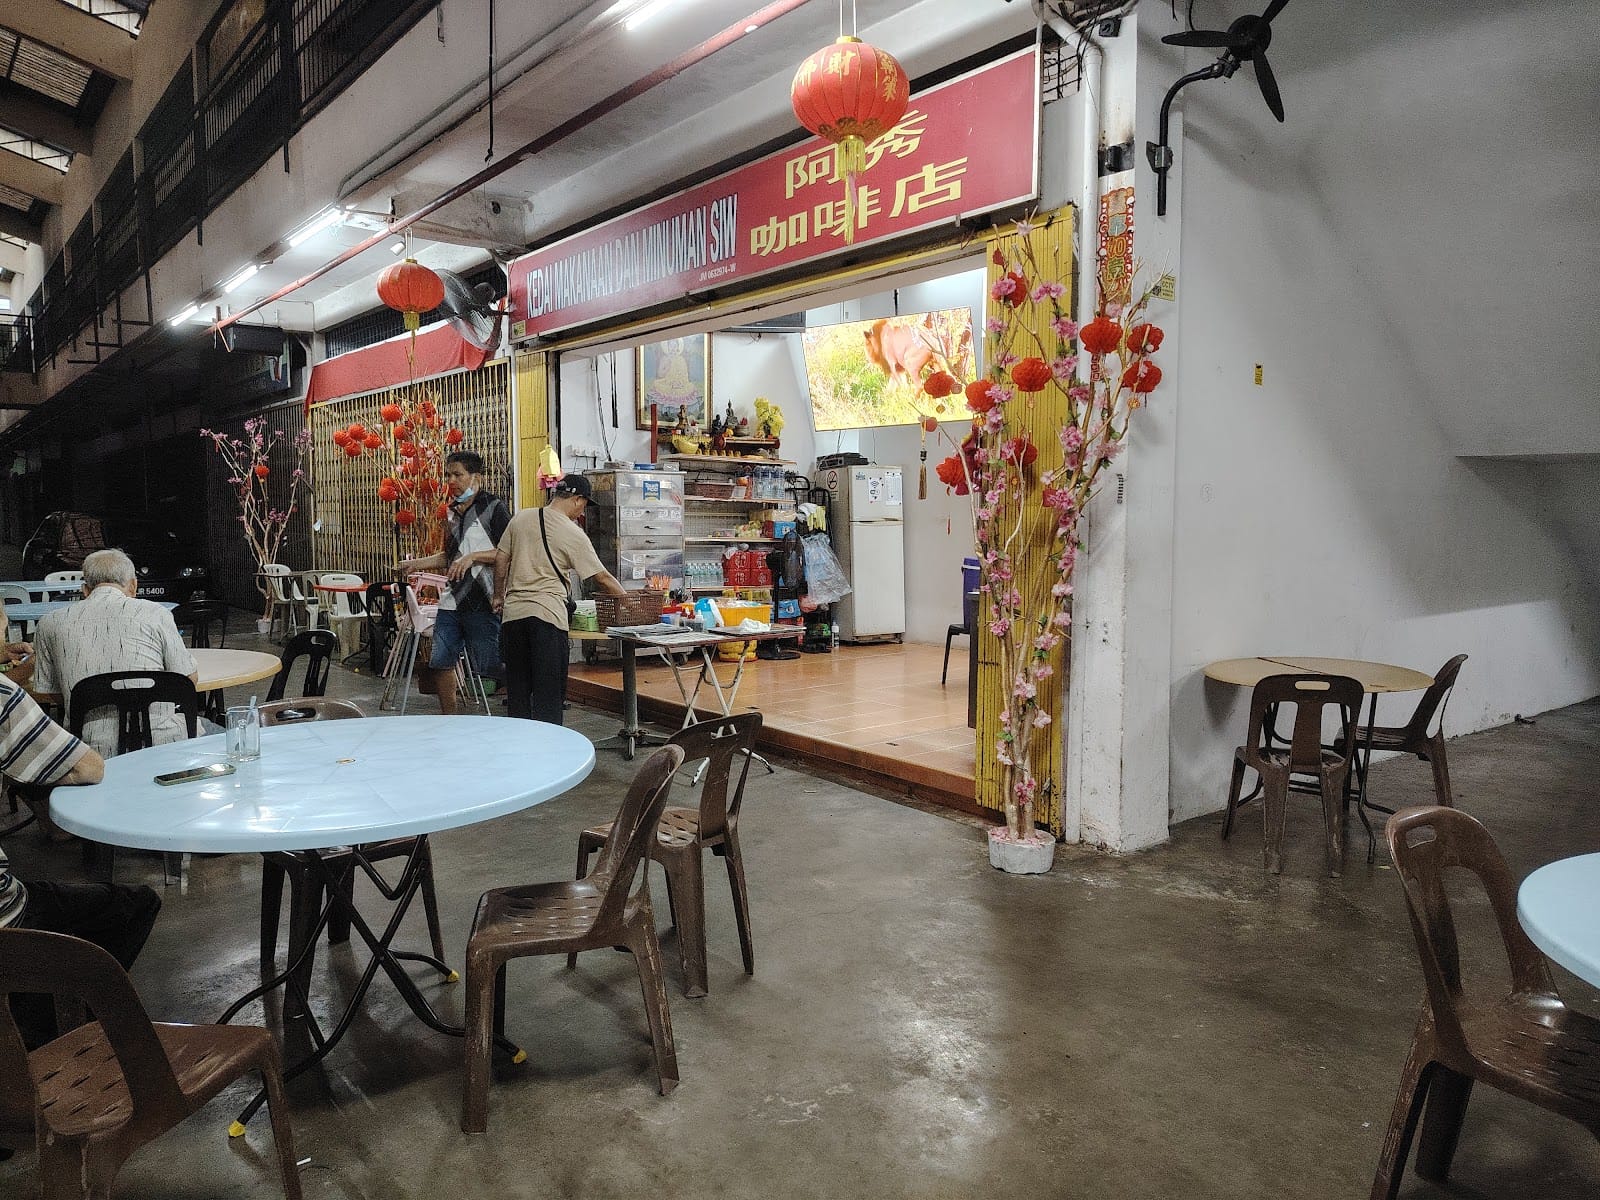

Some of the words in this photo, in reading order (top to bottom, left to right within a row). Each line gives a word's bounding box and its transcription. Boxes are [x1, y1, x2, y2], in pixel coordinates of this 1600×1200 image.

[785, 109, 928, 199] 阿秀
[750, 156, 968, 257] 咖啡店
[526, 262, 554, 319] KEDAI
[554, 241, 614, 310] MAKANAAN
[615, 231, 640, 293] DAN
[642, 205, 707, 284] MINUMAN
[710, 194, 738, 263] SIW
[146, 587, 165, 595] 5400
